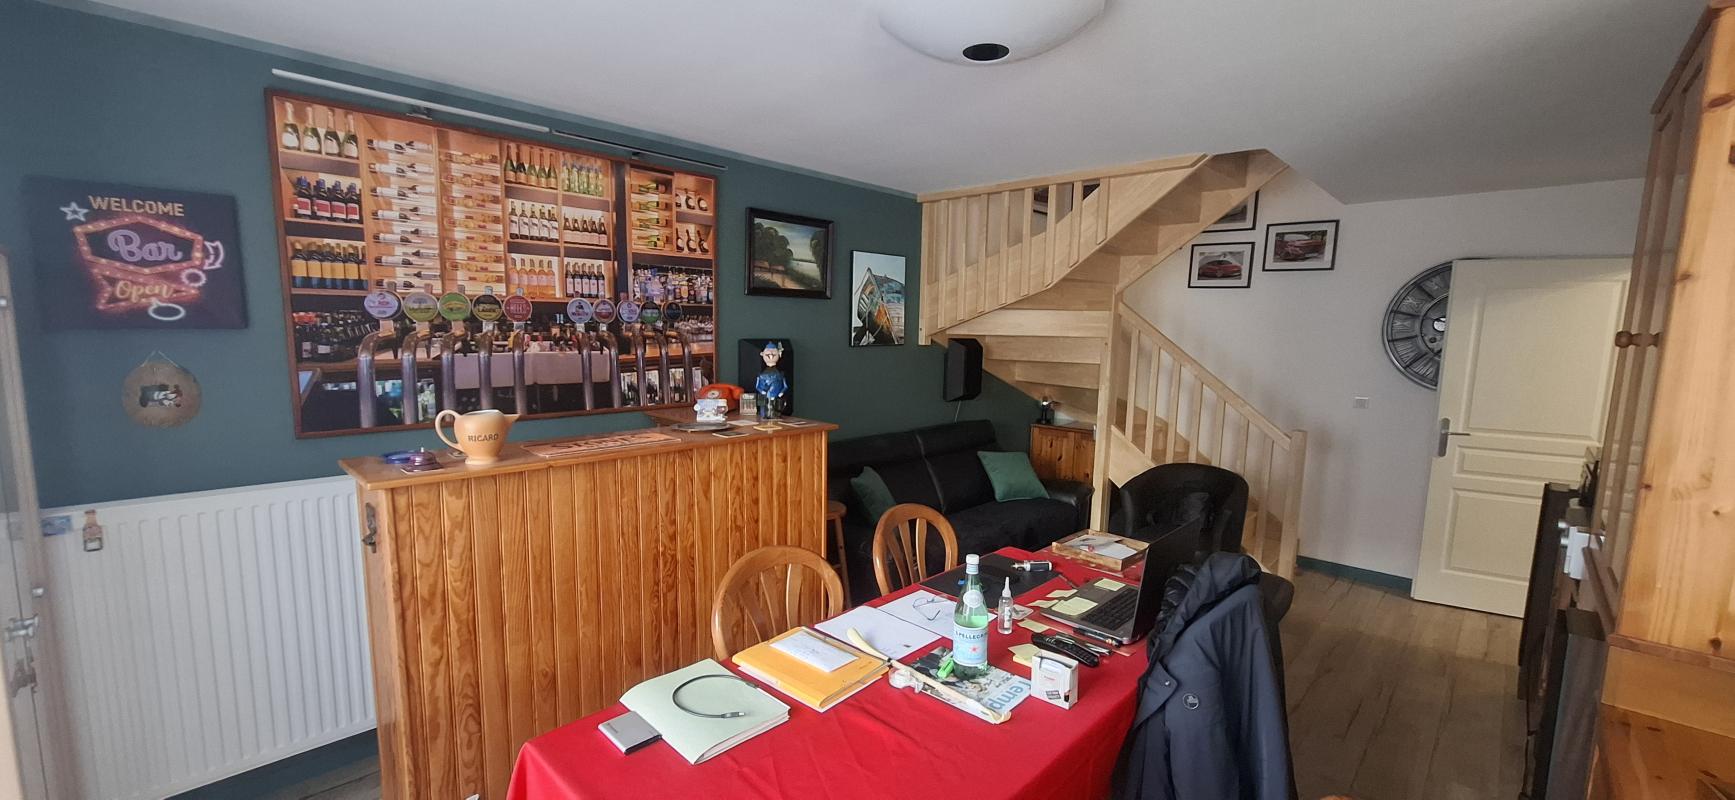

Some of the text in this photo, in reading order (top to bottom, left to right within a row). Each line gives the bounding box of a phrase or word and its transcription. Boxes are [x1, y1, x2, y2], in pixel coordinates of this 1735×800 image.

[88, 195, 184, 216] WELCOME
[107, 229, 183, 262] Bar
[115, 280, 174, 303] Open
[467, 433, 499, 442] RICARD
